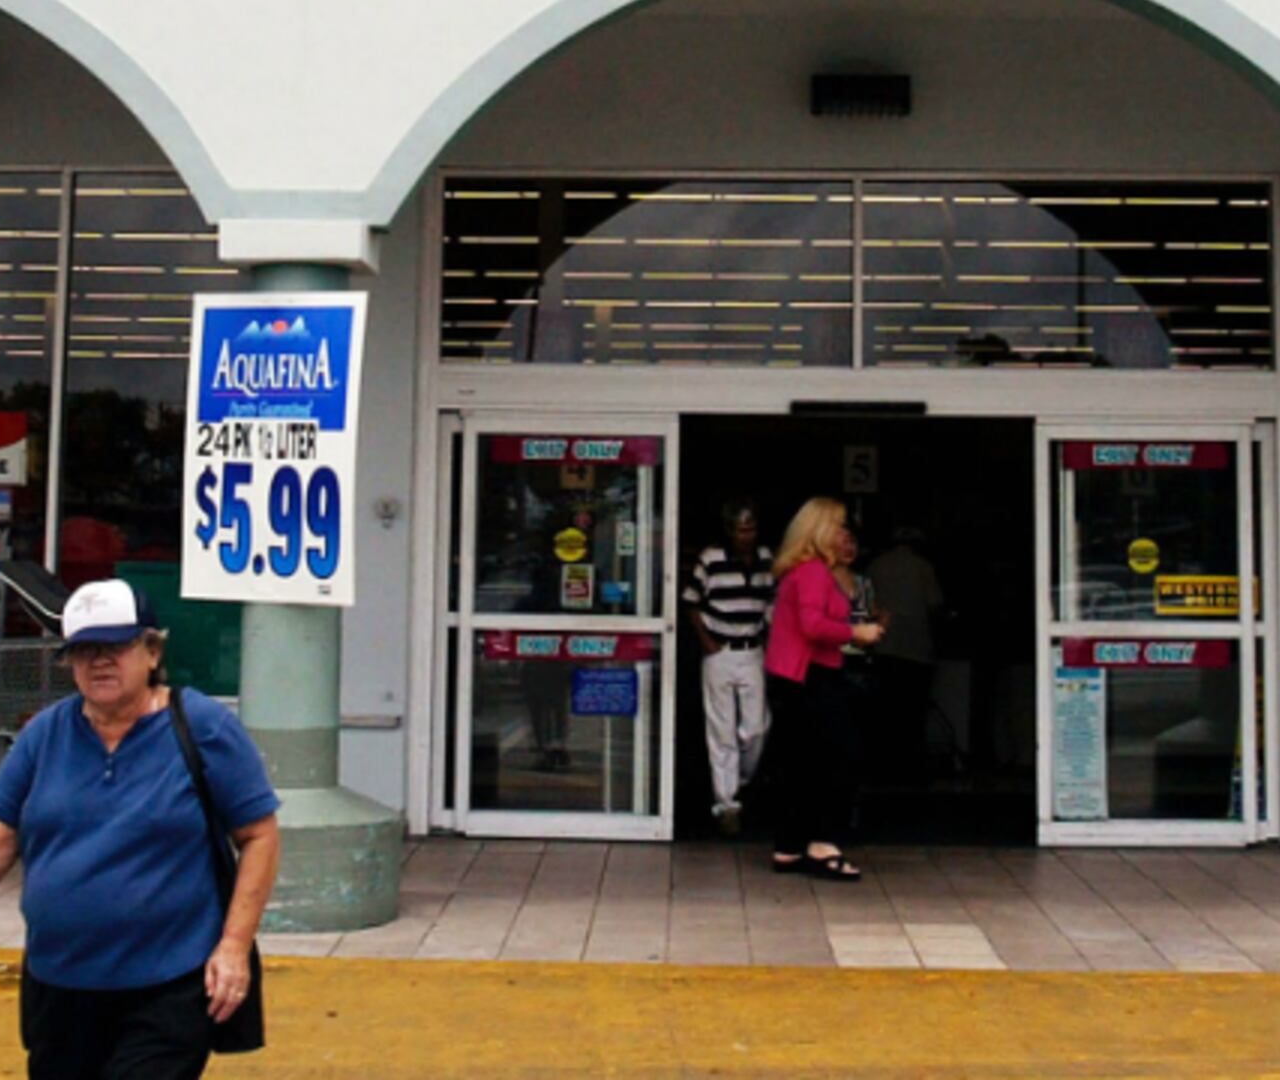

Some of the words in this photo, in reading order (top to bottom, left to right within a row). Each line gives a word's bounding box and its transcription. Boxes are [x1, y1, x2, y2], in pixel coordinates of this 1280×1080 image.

[212, 338, 333, 397] AQUAFINA
[276, 423, 317, 460] LITER
[572, 439, 623, 460] ONLY
[1144, 445, 1195, 466] ONLY
[195, 461, 341, 580] $5.99
[1144, 642, 1197, 663] ONLY
